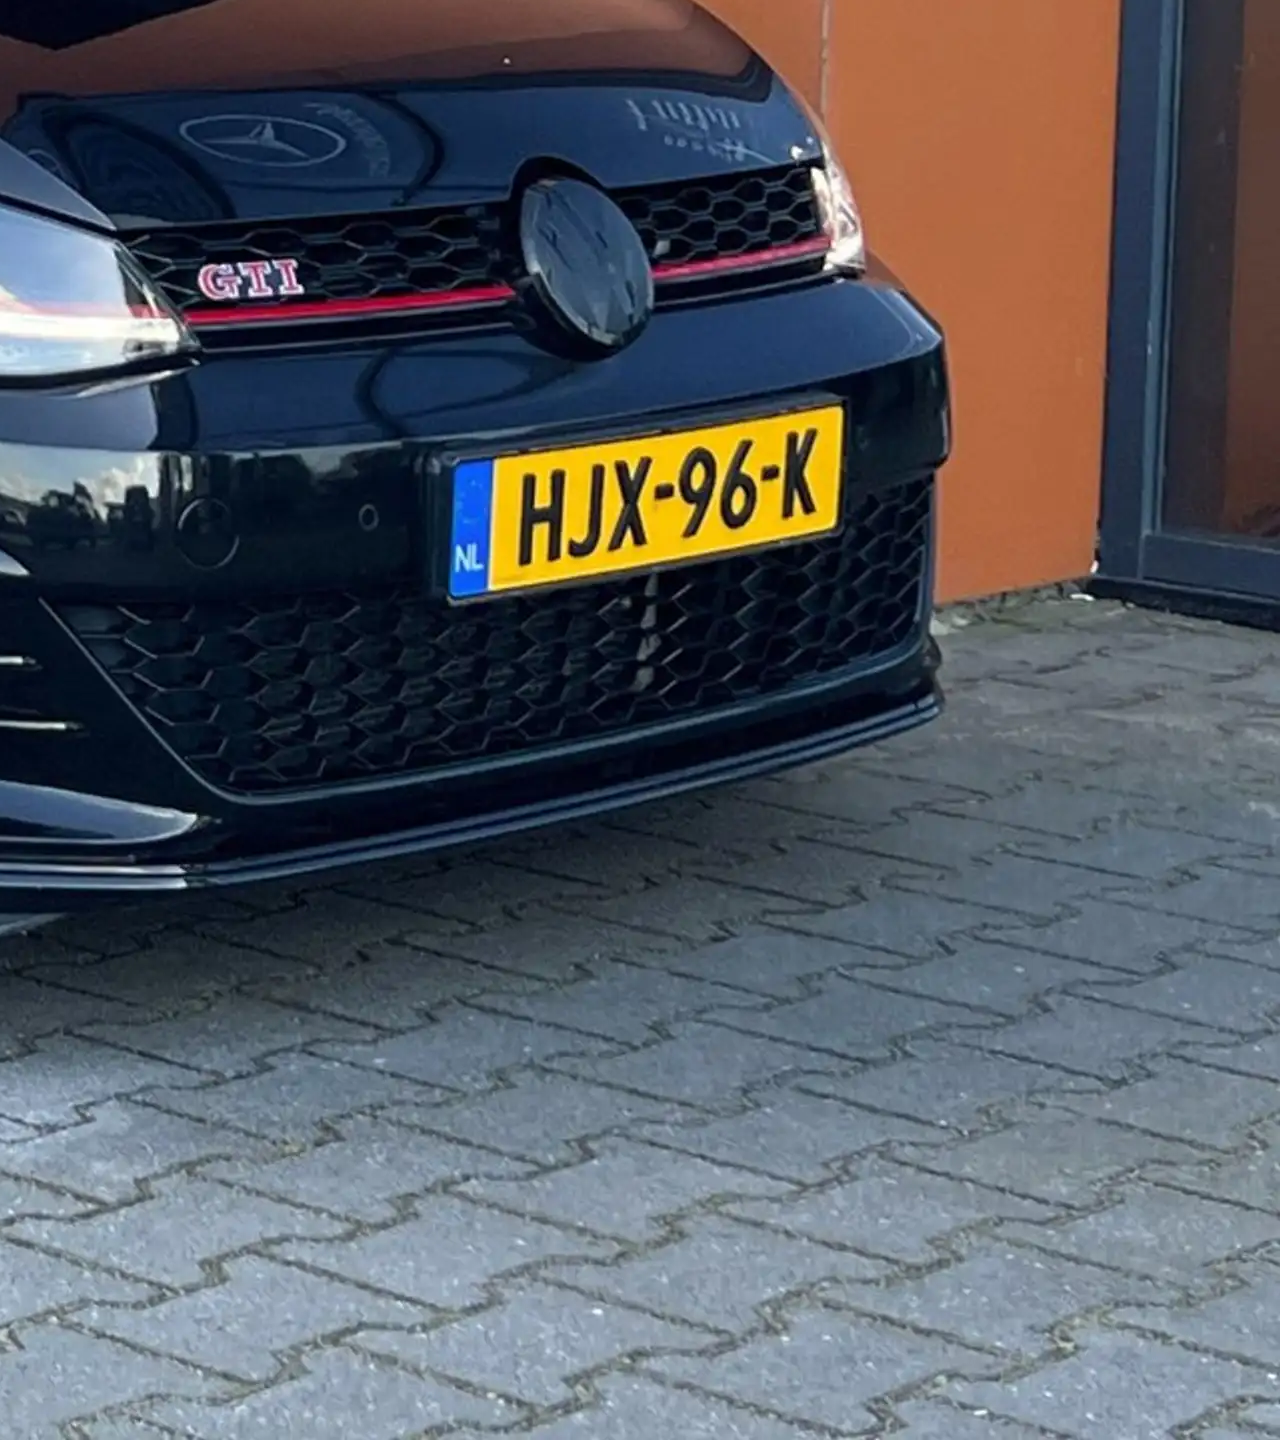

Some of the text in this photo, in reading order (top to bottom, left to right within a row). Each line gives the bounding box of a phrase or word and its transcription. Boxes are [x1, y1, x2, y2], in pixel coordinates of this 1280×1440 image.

[198, 258, 305, 301] GTI
[518, 427, 818, 566] HJX-96-K
[454, 543, 484, 573] NL
